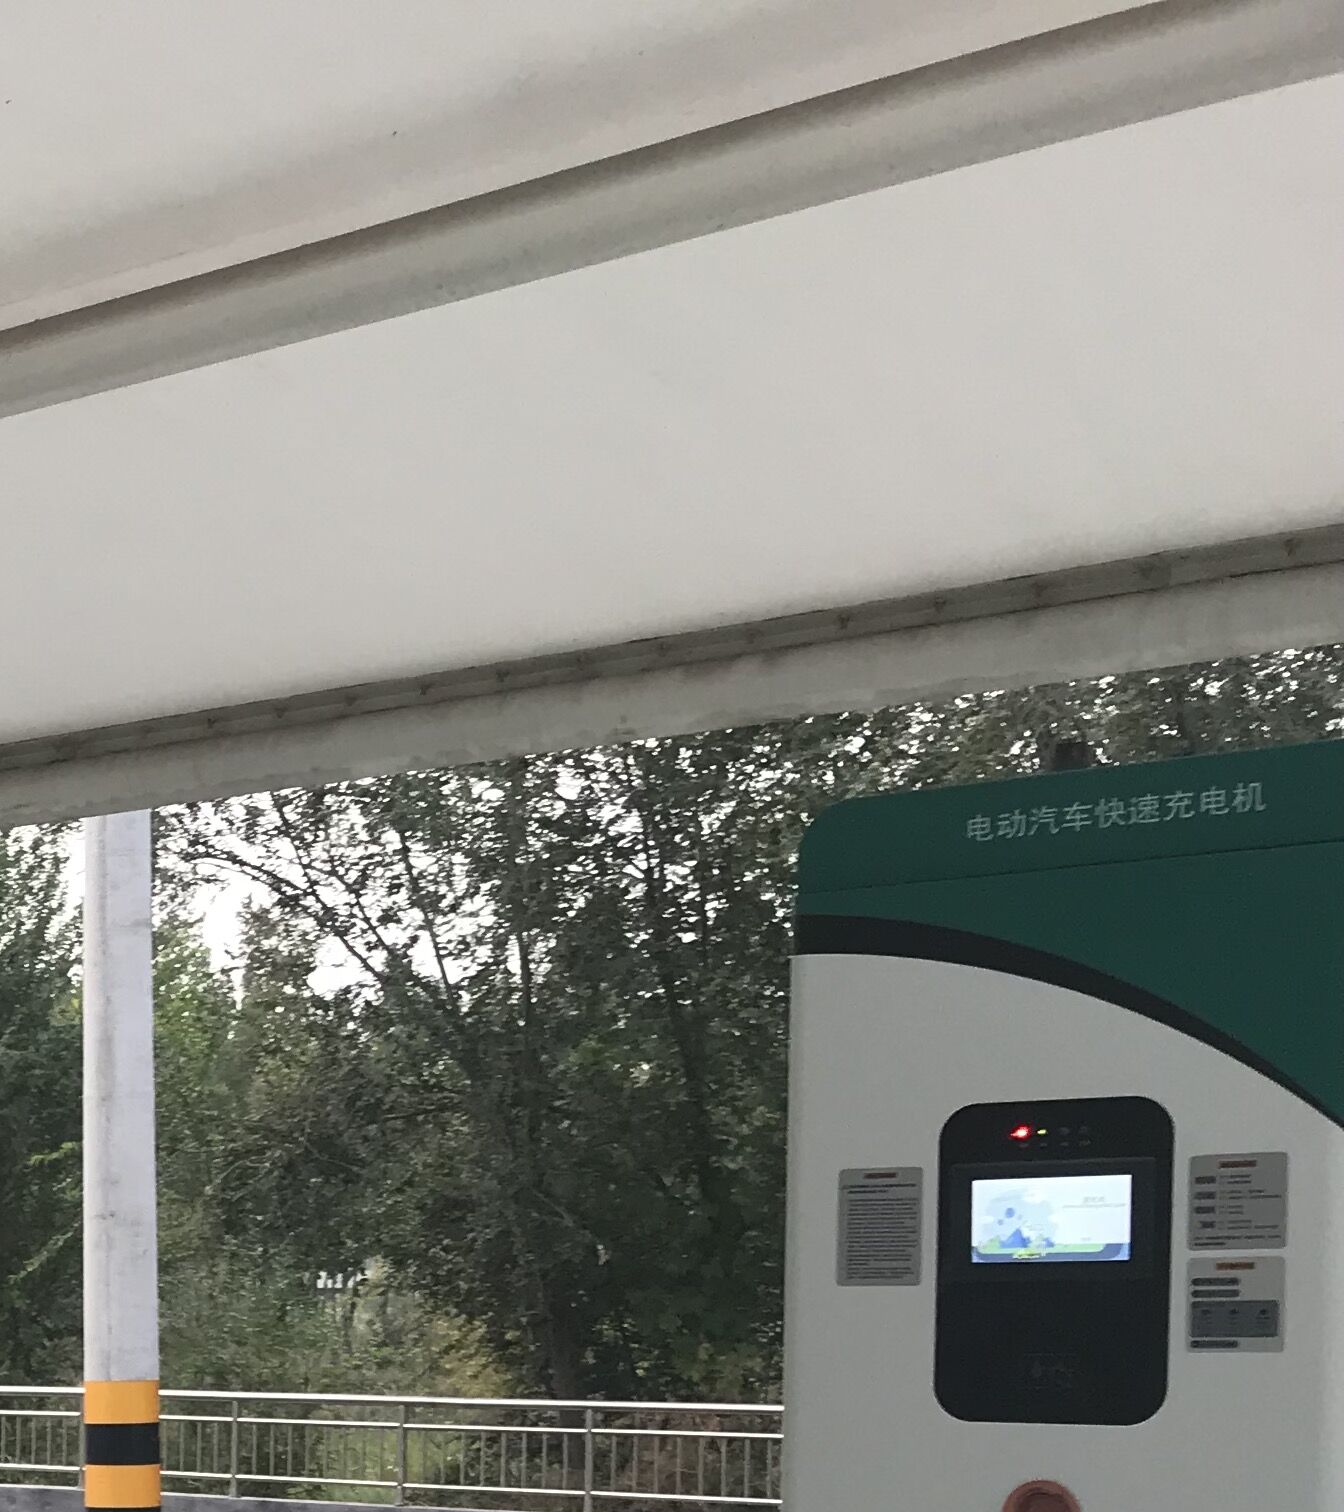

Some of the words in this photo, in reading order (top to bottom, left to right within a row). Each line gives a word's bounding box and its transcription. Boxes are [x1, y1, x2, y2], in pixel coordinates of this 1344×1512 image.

[965, 782, 1267, 842] 电动汽车快速充电机
